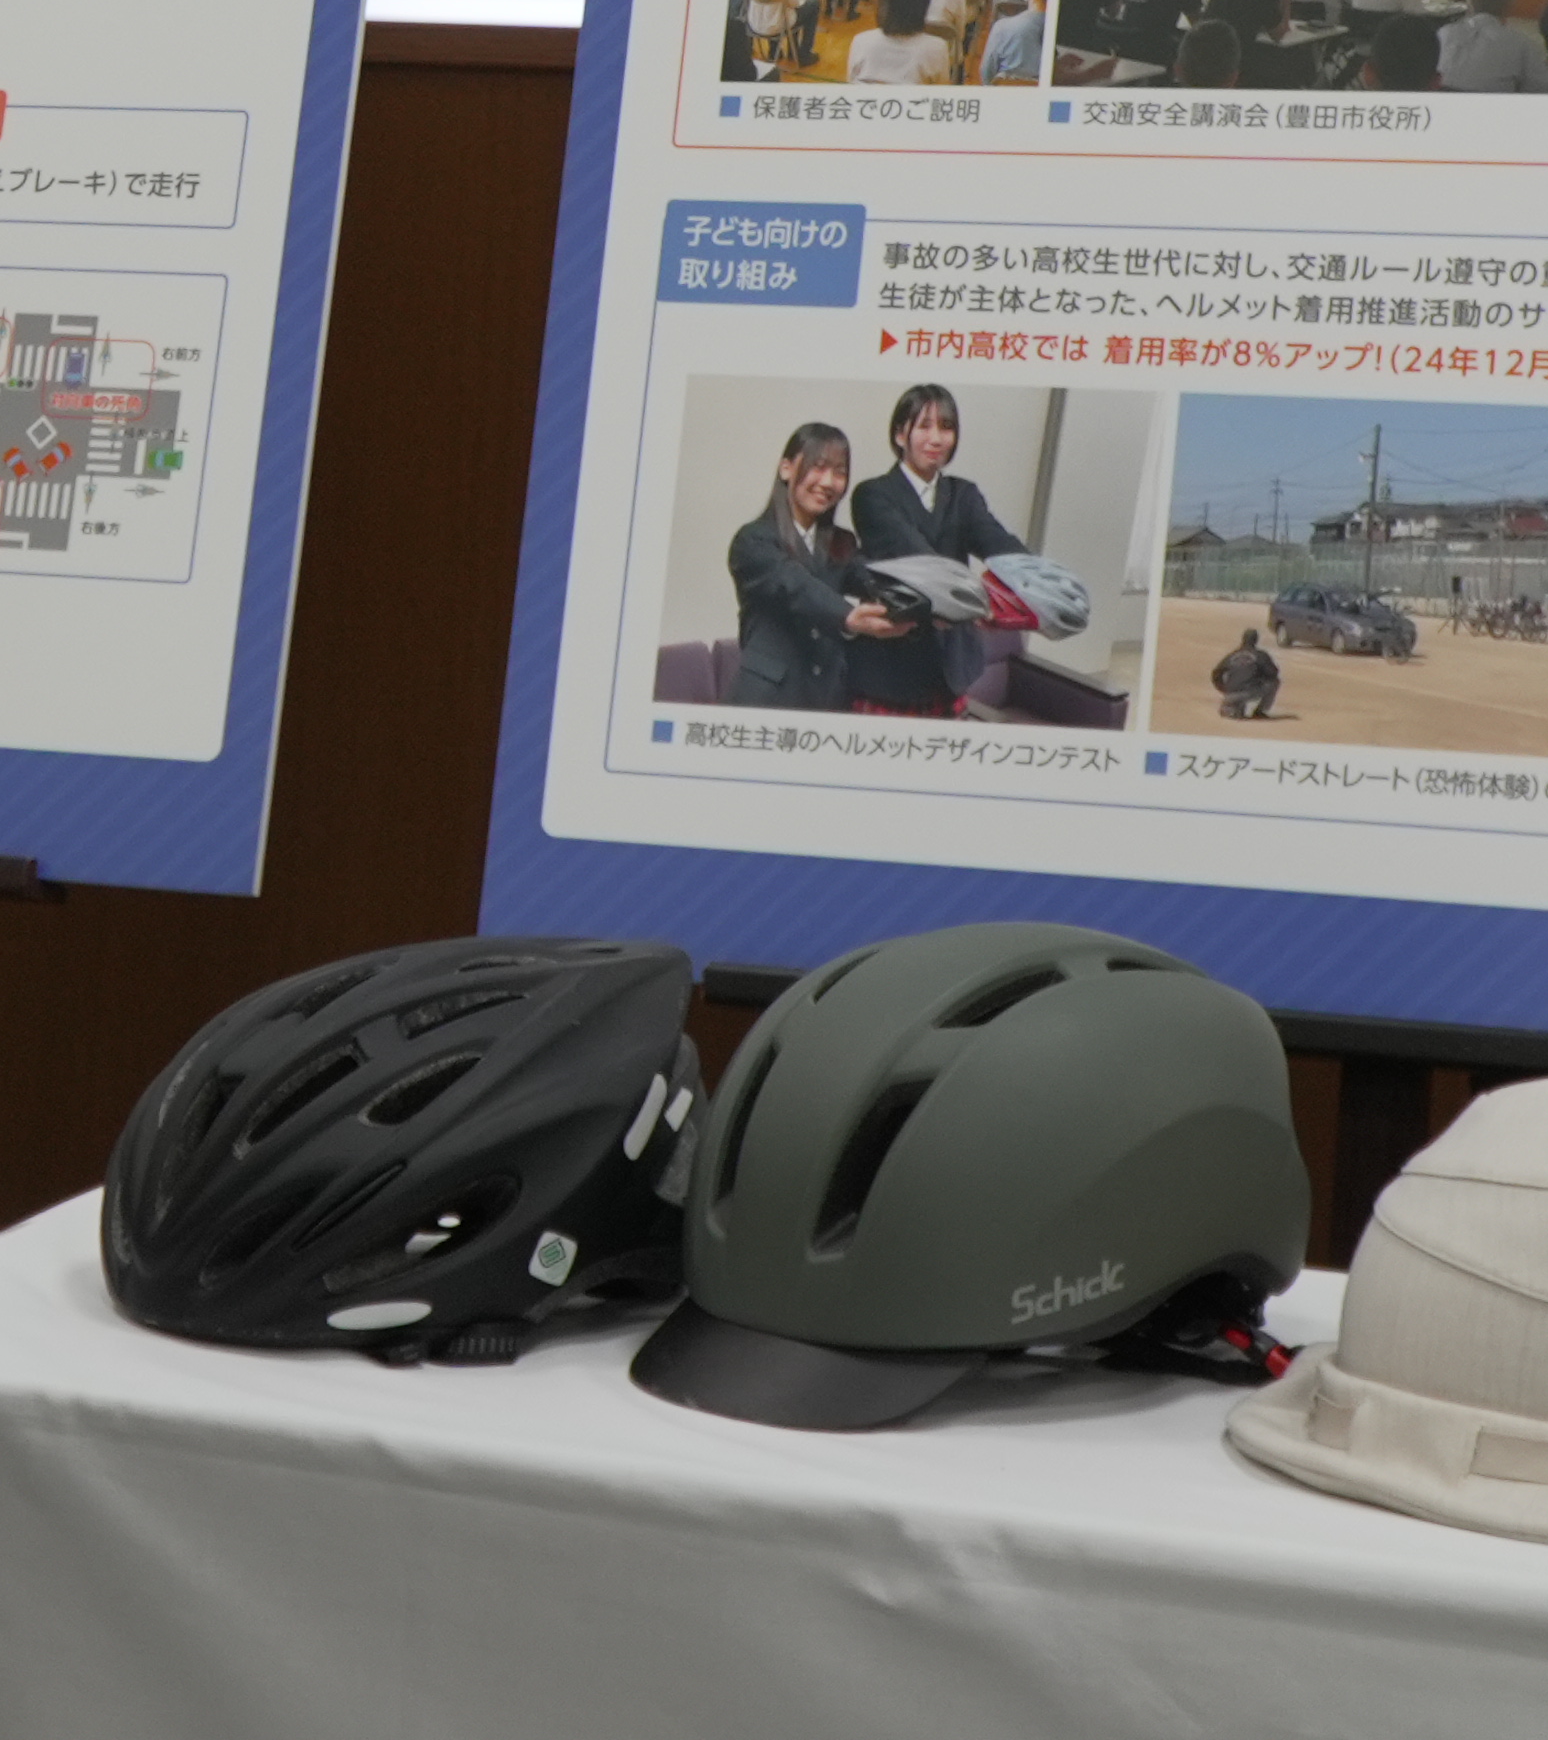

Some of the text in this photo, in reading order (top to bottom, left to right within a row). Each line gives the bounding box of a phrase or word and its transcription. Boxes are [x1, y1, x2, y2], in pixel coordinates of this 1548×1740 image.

[752, 93, 981, 124] 保護者会でのご説明
[1082, 98, 1433, 132] 交通安全講演会(豊田市役所)
[684, 217, 847, 248] 子ども向けの
[678, 260, 797, 291] 取り組み
[684, 721, 1121, 772] 高校生主導のヘルメットデザインコンテスト
